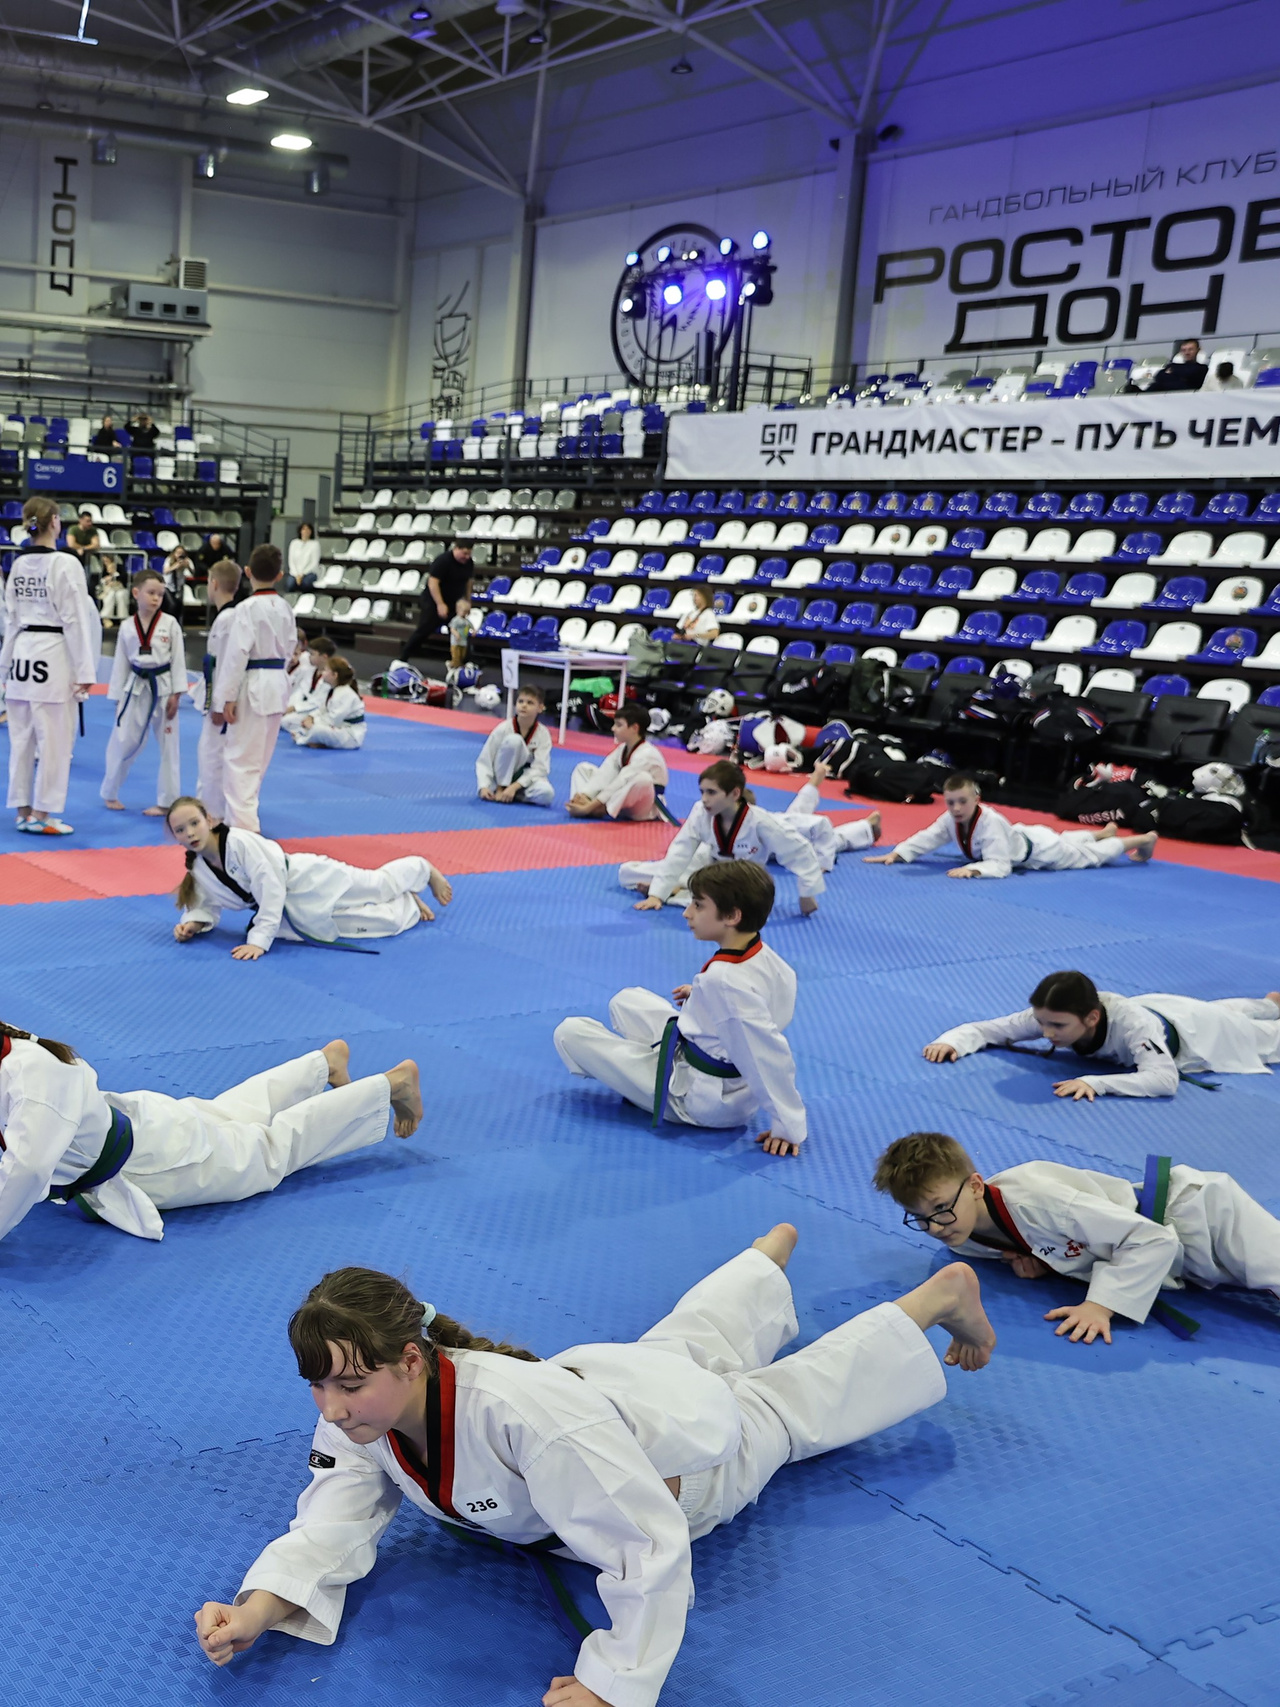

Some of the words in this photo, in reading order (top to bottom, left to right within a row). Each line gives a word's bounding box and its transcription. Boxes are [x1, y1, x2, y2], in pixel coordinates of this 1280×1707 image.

[928, 166, 1165, 225] ГАНДБОЛЬНЫЙ
[1176, 150, 1278, 186] КЛУБ
[50, 156, 78, 297] ДОН
[944, 274, 1224, 354] ДОН
[810, 426, 1043, 459] ГРАНДМАСТЕР
[1074, 421, 1177, 452] ПУТЬ
[102, 466, 118, 488] 6
[1078, 808, 1125, 825] RUSSIA
[466, 1498, 498, 1513] 236
